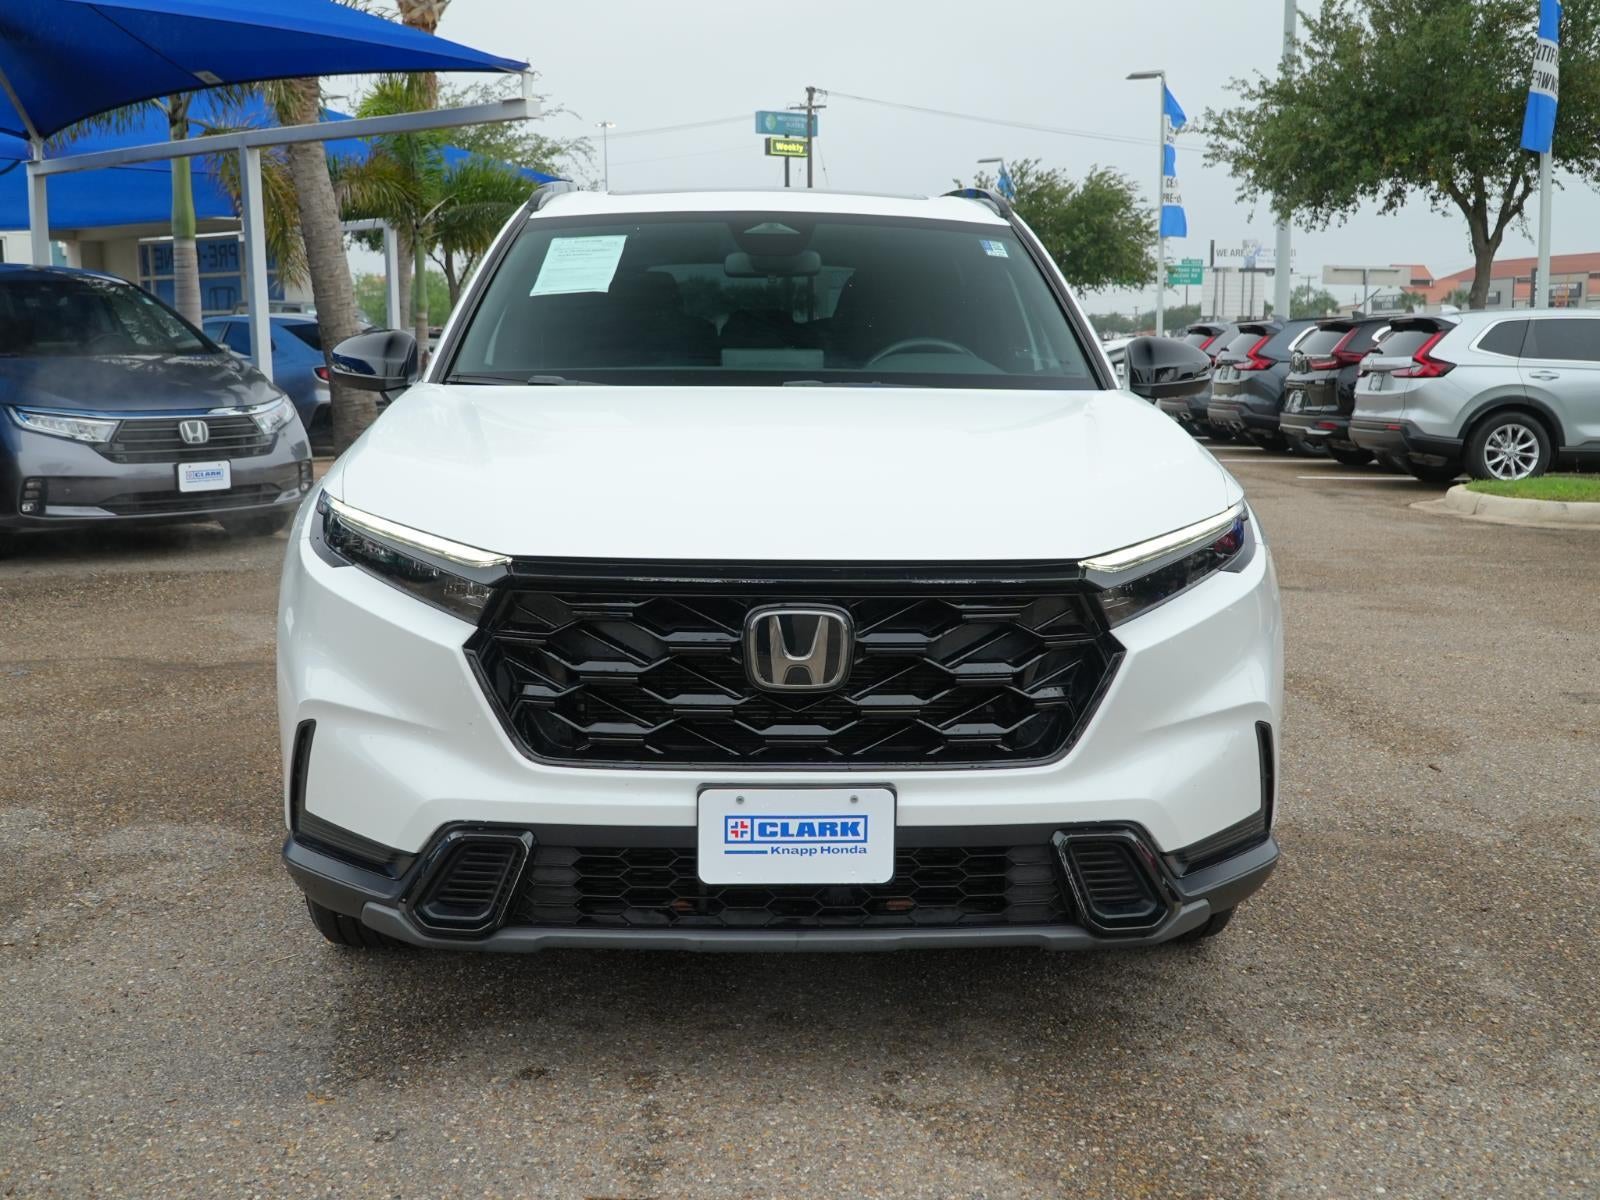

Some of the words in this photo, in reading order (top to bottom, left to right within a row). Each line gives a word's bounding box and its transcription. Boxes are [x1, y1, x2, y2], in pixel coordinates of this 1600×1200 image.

[775, 142, 804, 154] Weekly
[1215, 248, 1228, 257] WE
[757, 821, 862, 838] CLARK
[770, 846, 818, 857] Knapp
[820, 845, 868, 855] Honda
